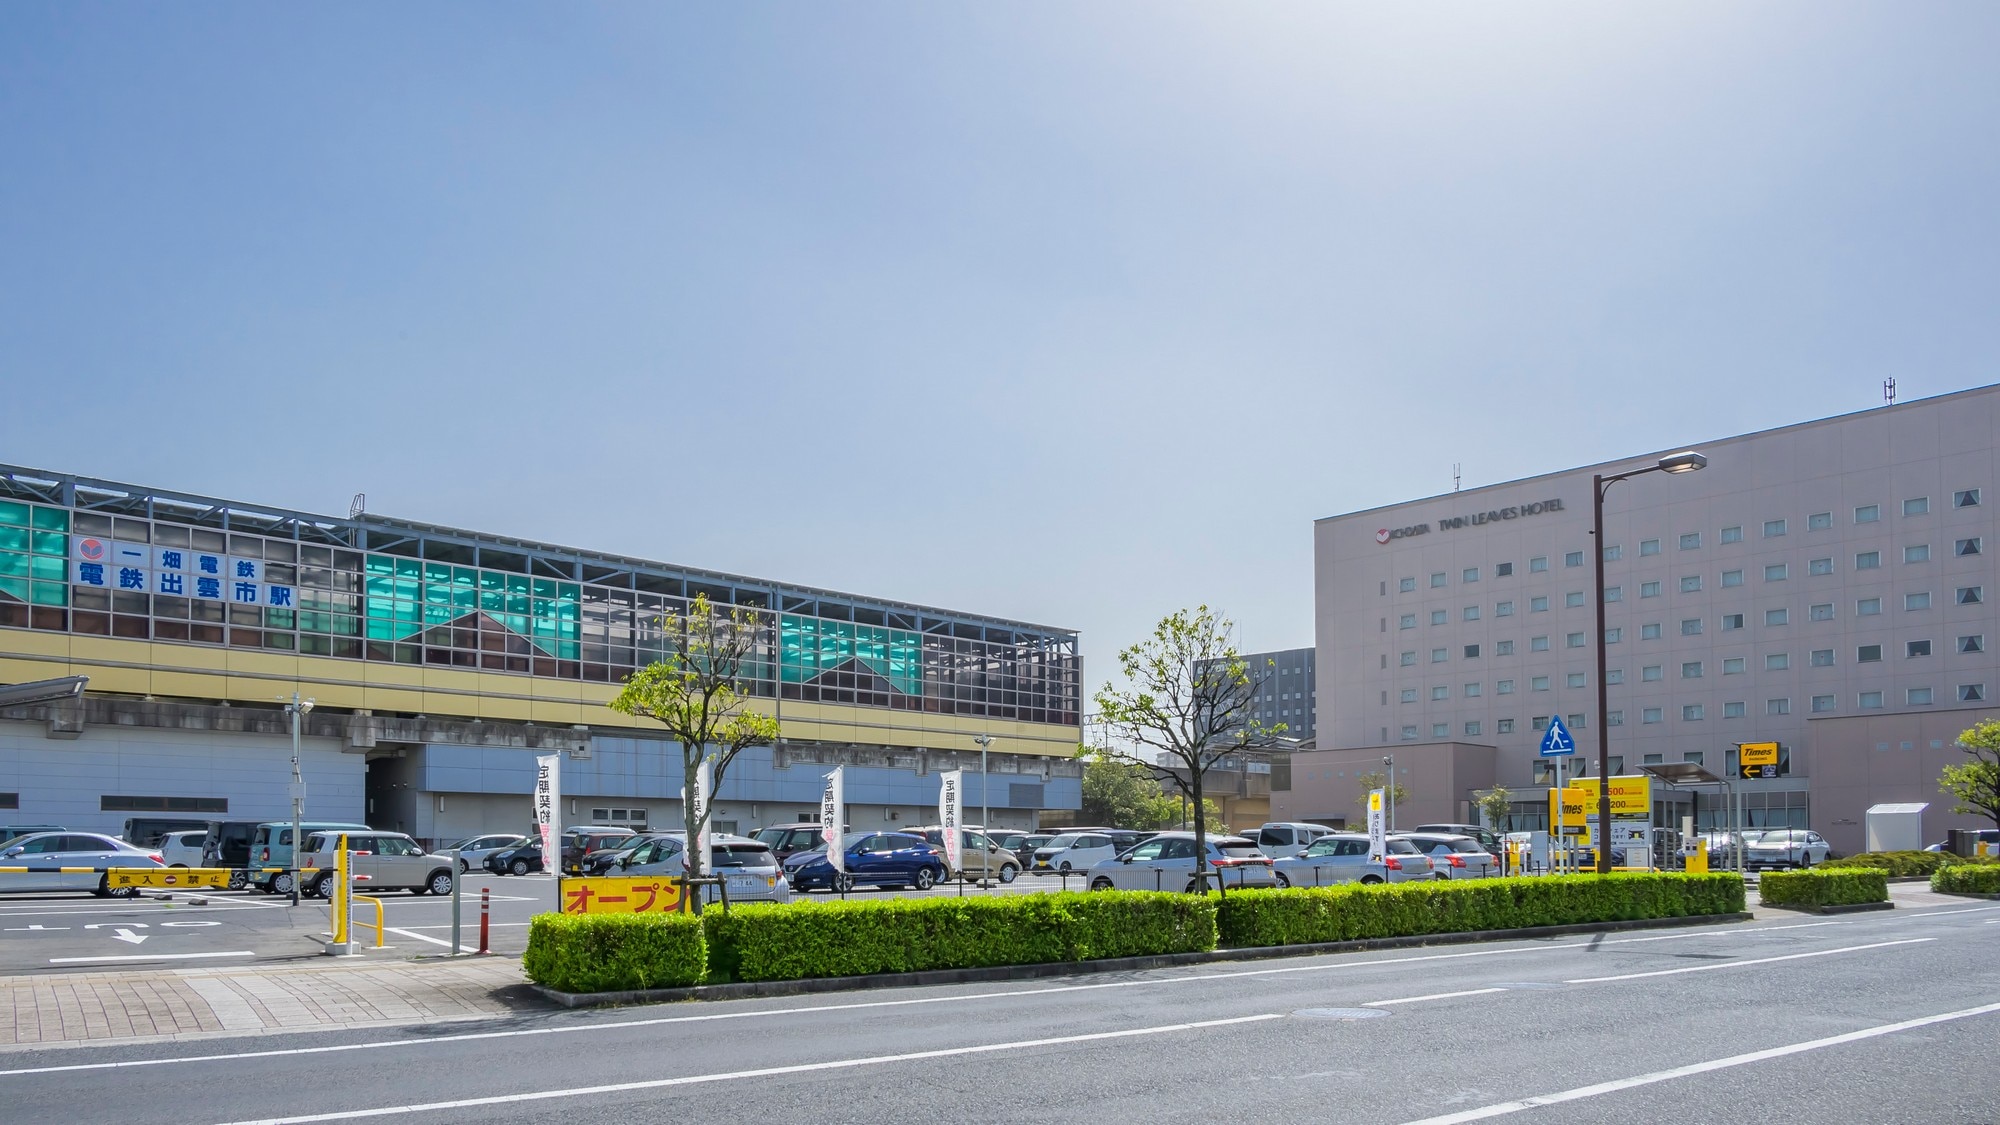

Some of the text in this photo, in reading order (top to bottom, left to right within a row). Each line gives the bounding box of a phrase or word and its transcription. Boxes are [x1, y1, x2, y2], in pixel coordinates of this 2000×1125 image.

[1438, 519, 1470, 532] TWIN
[1472, 506, 1519, 526] LEAVES
[1521, 498, 1565, 517] HOTEL
[122, 550, 254, 579] 一畑電鉄
[79, 562, 292, 607] 電鉄出雲市駅
[1744, 748, 1773, 757] Times
